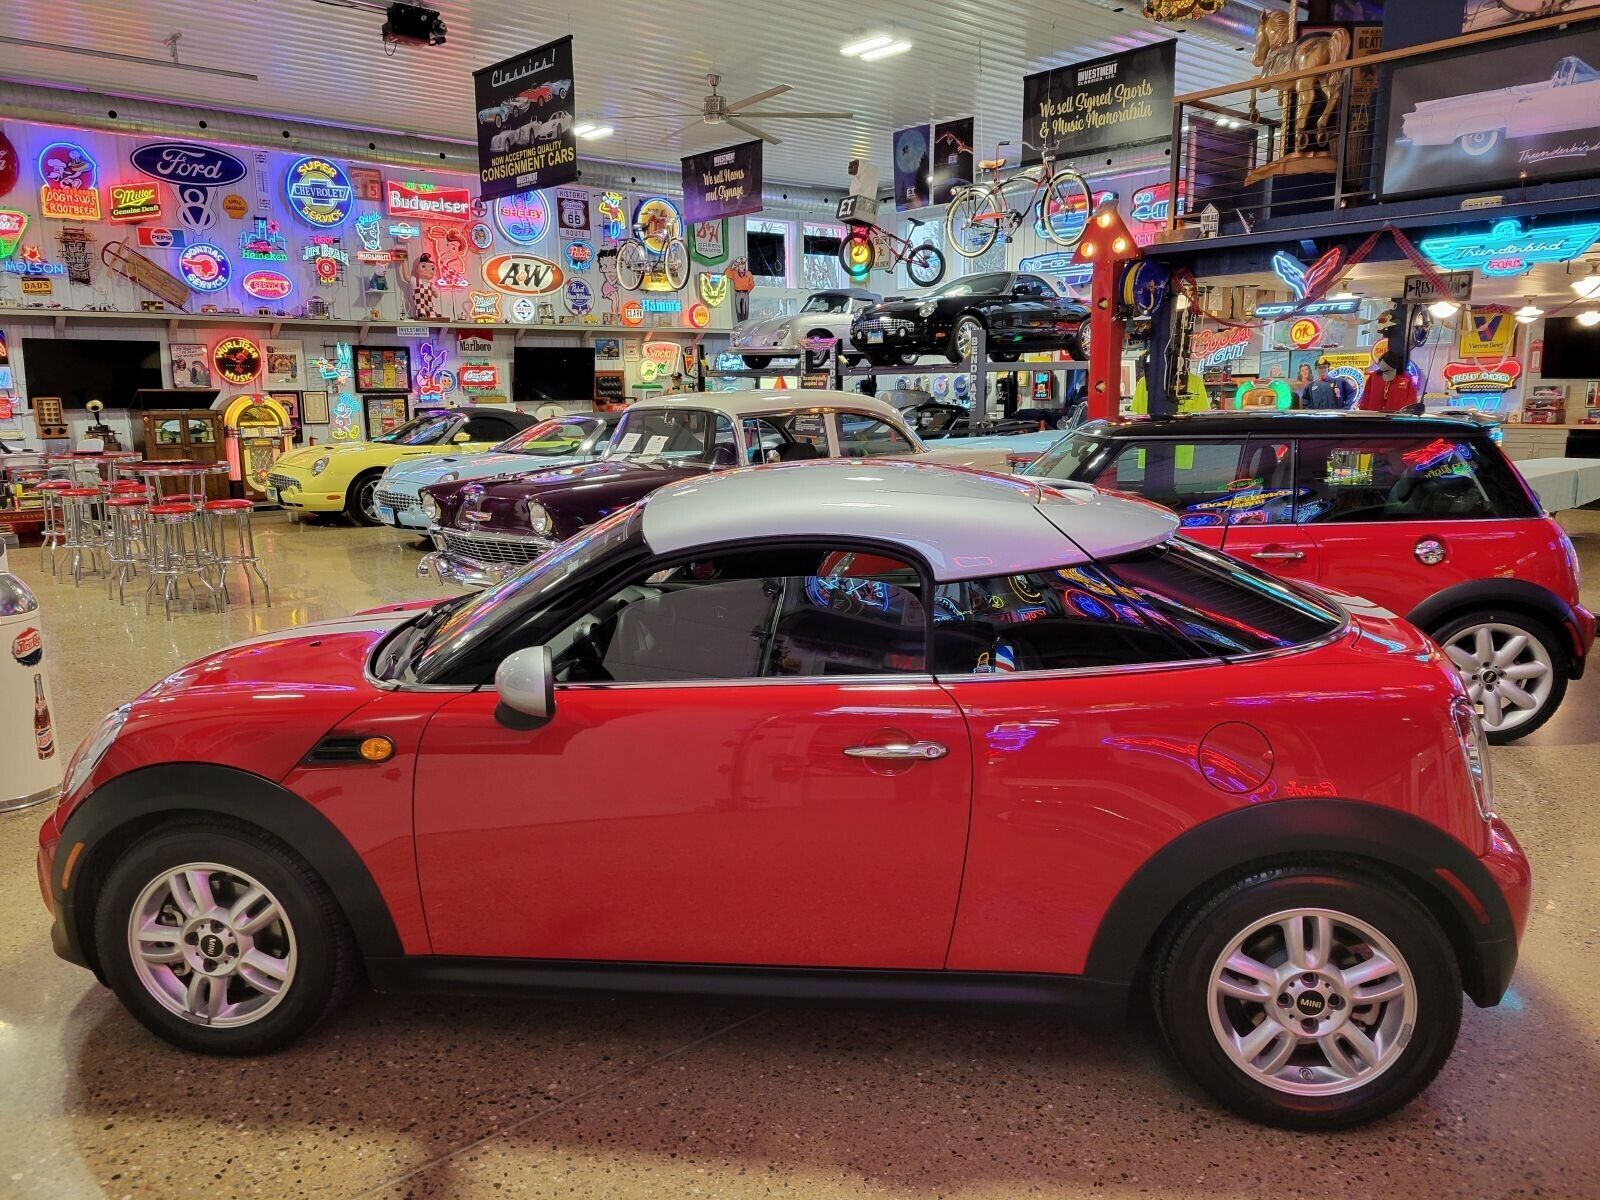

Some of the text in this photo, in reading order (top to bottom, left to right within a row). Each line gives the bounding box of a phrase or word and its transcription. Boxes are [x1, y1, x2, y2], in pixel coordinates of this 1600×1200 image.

[492, 48, 556, 88] Classics!
[1078, 62, 1118, 82] INVESTMENT
[1040, 79, 1153, 118] We sell Signed Sports
[1040, 122, 1050, 138] &
[1052, 116, 1084, 136] Music
[492, 140, 562, 166] NOW ACCEPTING QUALITY
[156, 148, 222, 178] Ford
[297, 161, 337, 178] SUPER
[482, 146, 574, 182] CONSIGNMENT CARS
[703, 169, 744, 186] We sell Neons
[114, 189, 155, 206] Miller
[294, 186, 344, 198] CHEVROLET
[560, 190, 586, 199] HISTORIC
[706, 186, 744, 202] and Signage
[390, 190, 469, 213] Budweiser
[113, 206, 140, 215] Genuine
[302, 206, 344, 223] SERVICE
[502, 207, 544, 219] SHELBY
[568, 214, 581, 224] 66
[183, 246, 224, 262] PONTIAC
[242, 250, 287, 261] Heineken
[303, 244, 350, 266] JIM BEAM
[1456, 240, 1565, 259] Thunderbird
[6, 261, 63, 274] MOLSON
[498, 263, 552, 287] A&W
[186, 274, 227, 290] SERVICE
[626, 310, 643, 318] CLARK
[642, 300, 680, 312] Hamm's
[1294, 324, 1311, 340] OK
[216, 340, 258, 359] WURLITZER
[460, 340, 492, 352] Marlboro
[1193, 327, 1250, 358] Coors
[647, 347, 678, 359] Sinclair
[1198, 342, 1248, 373] LIGHT
[225, 370, 252, 382] MUSIC
[1482, 373, 1510, 381] CHICAGO
[1300, 998, 1321, 1009] MINI
